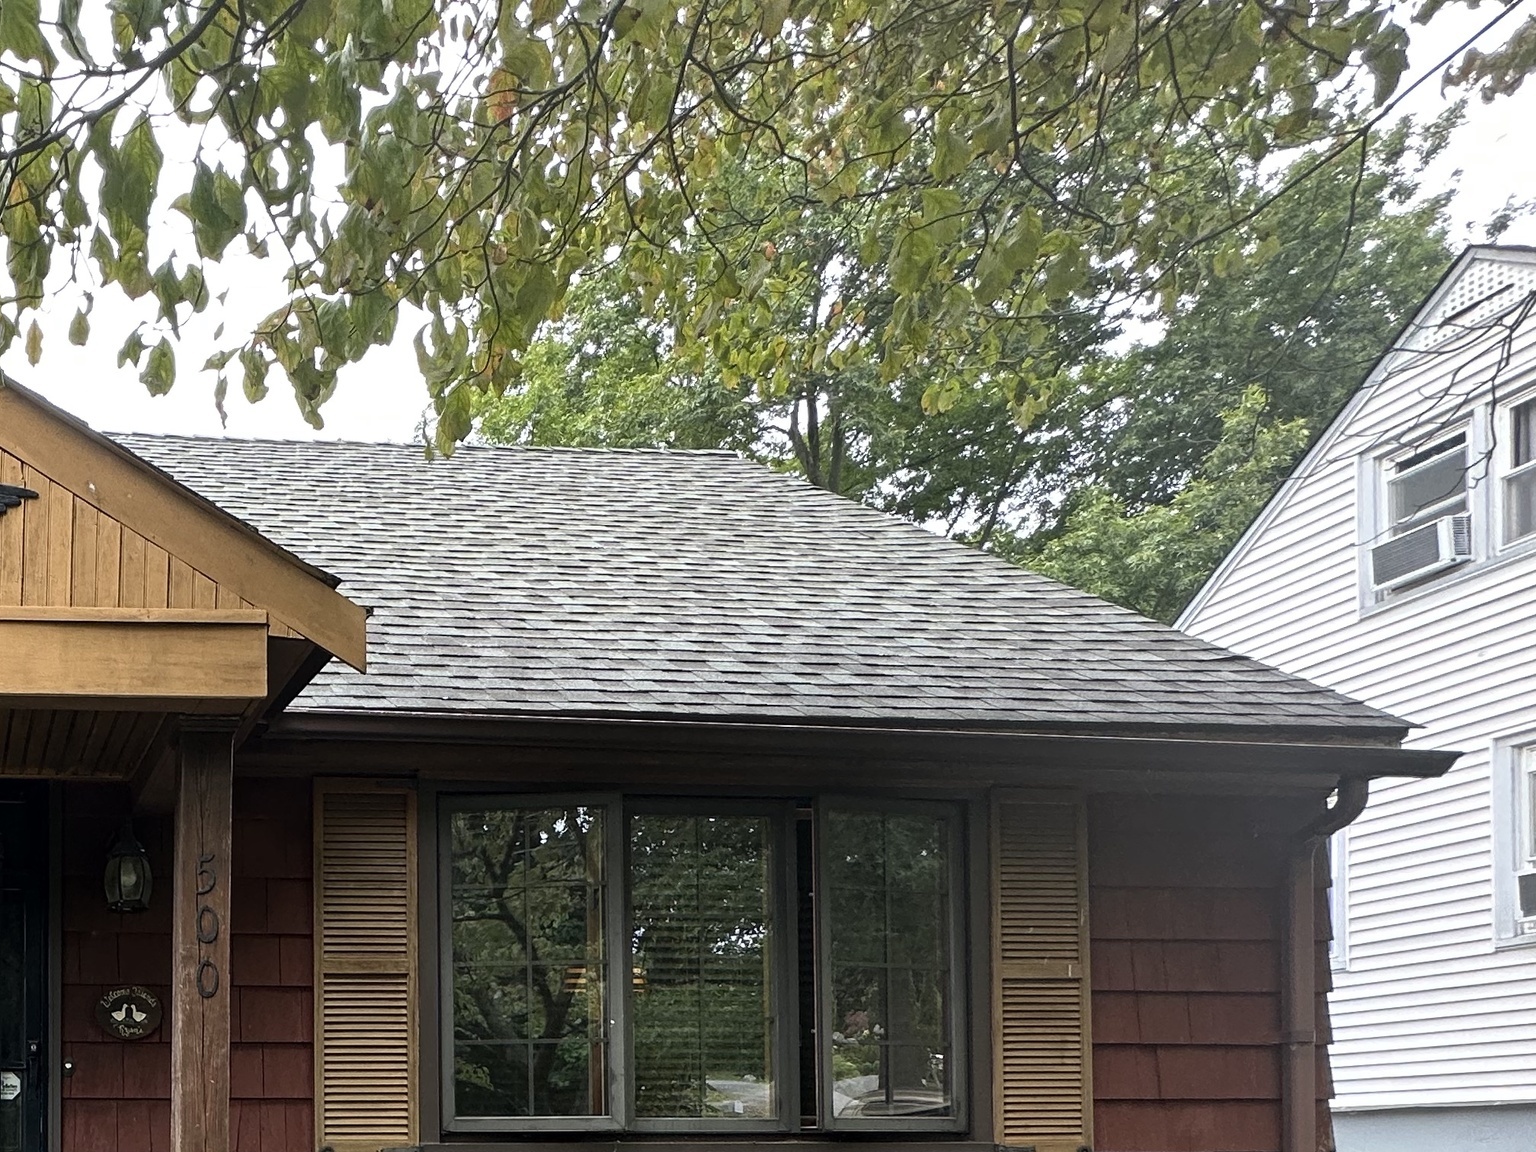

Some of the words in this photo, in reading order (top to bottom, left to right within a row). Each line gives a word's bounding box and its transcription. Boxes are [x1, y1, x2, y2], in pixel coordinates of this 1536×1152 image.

[196, 853, 220, 999] 500
[100, 988, 130, 1009] Welcome
[131, 986, 158, 1008] Friends
